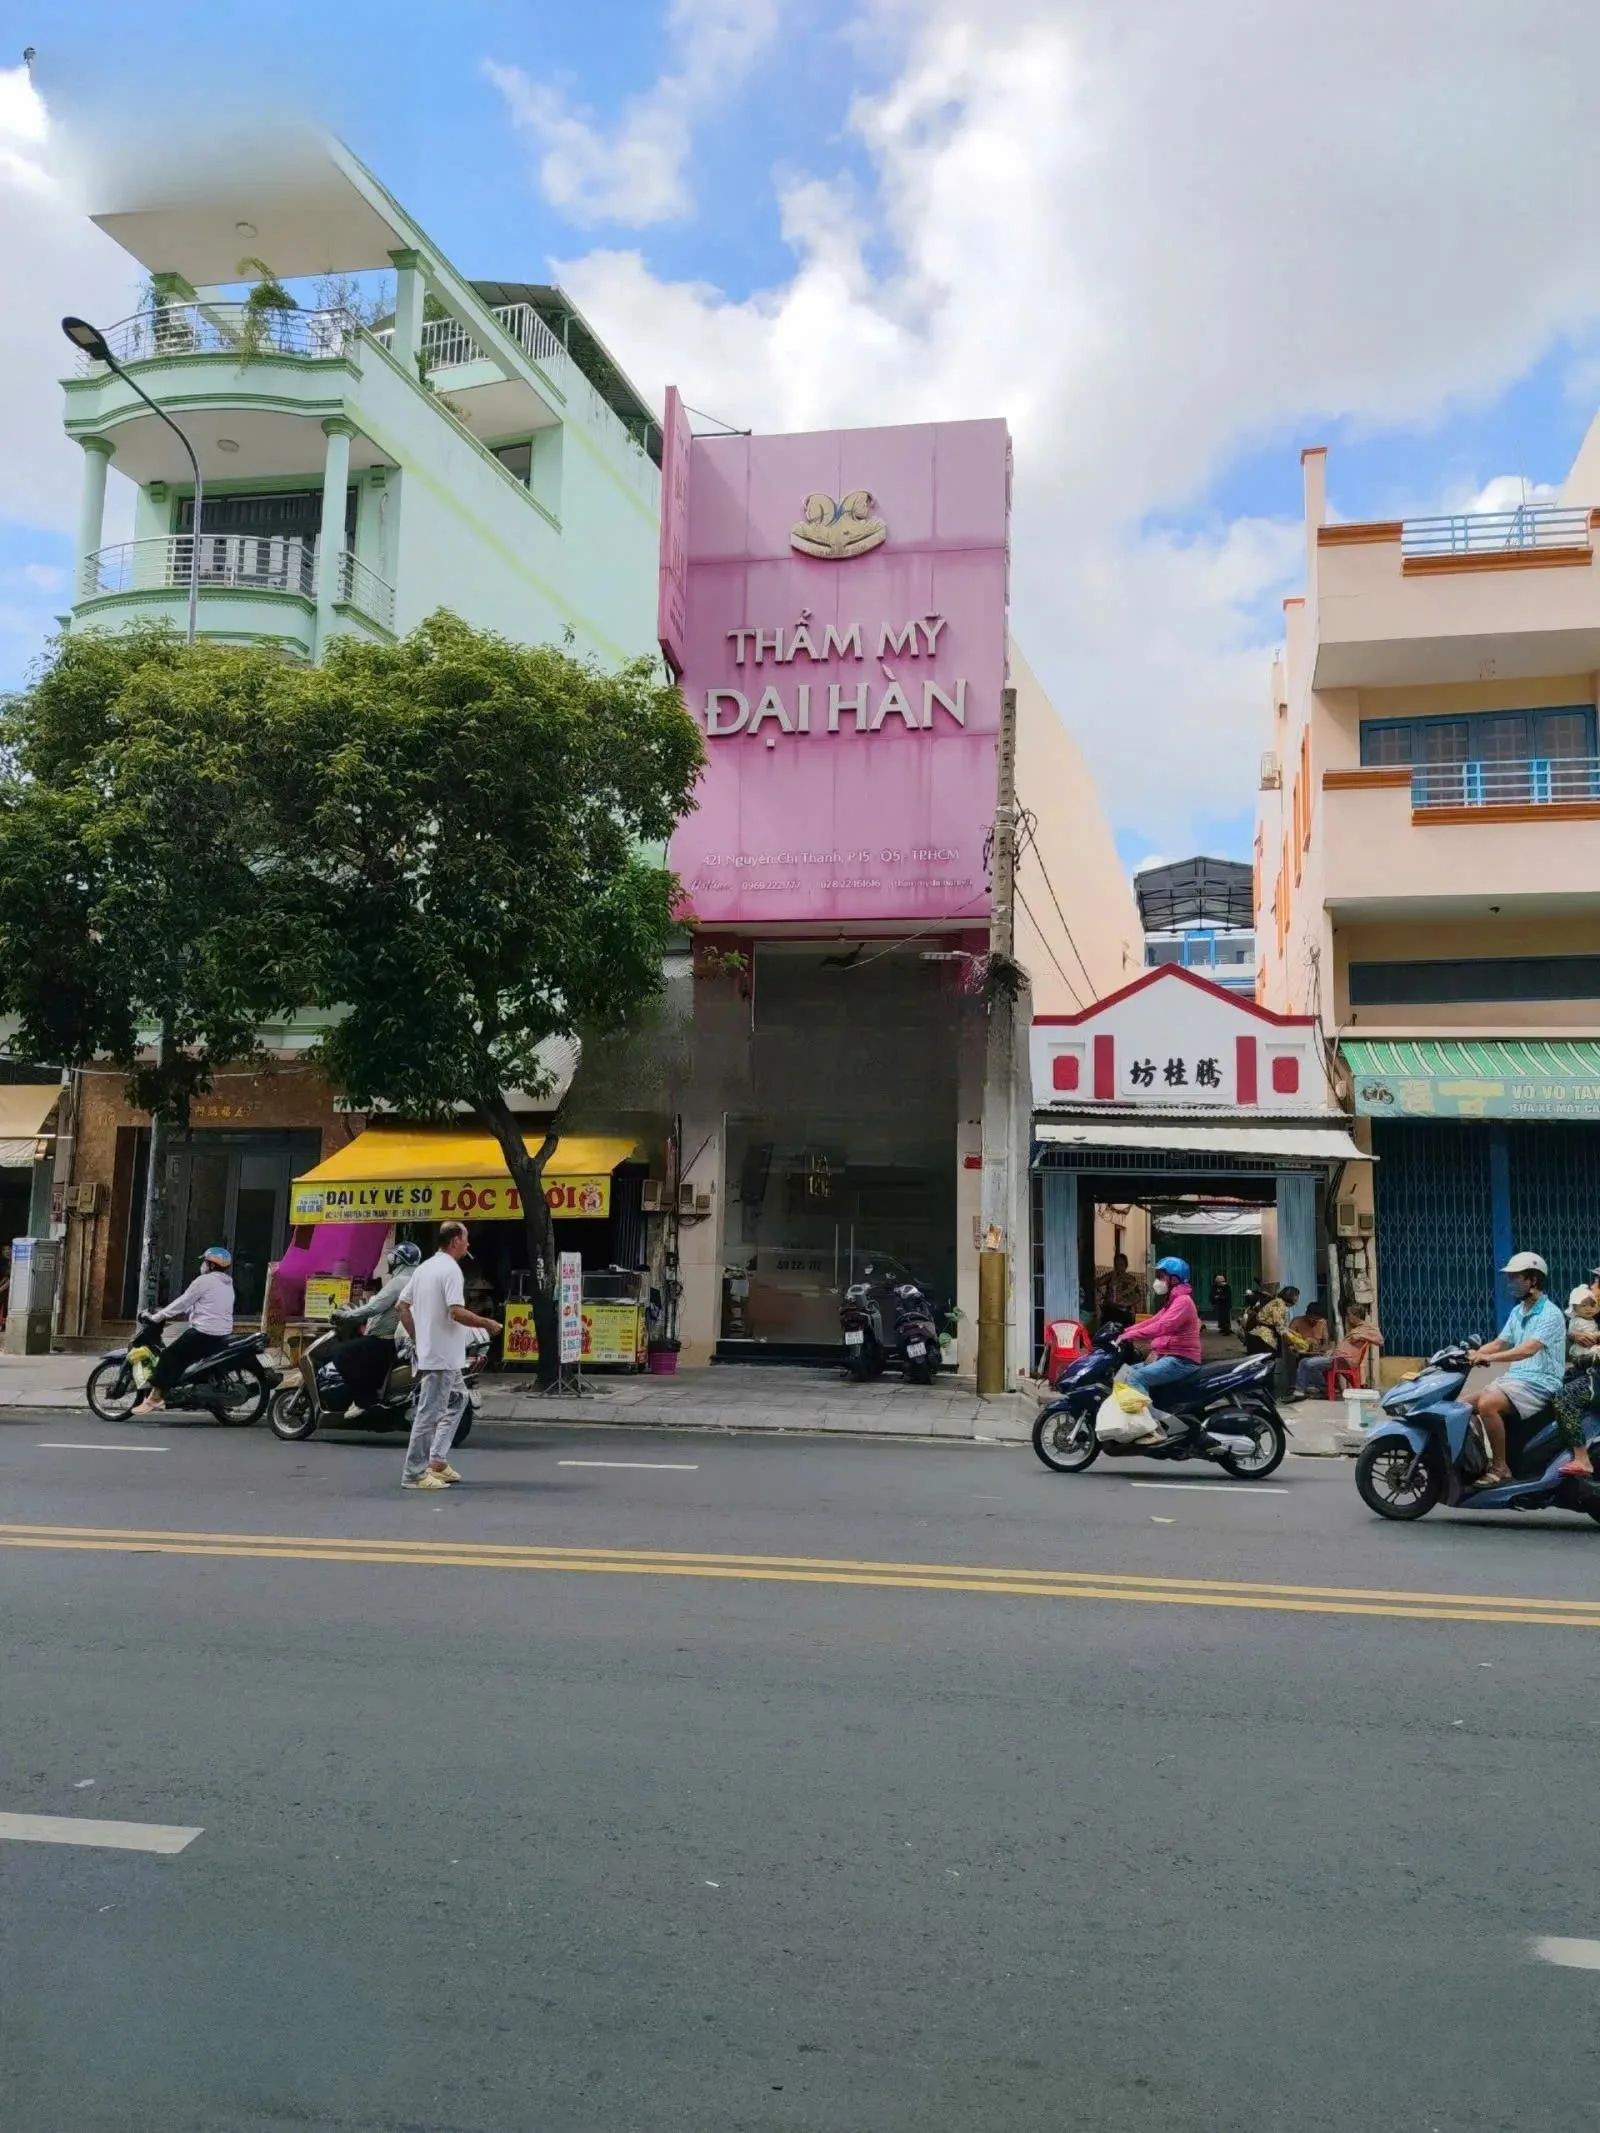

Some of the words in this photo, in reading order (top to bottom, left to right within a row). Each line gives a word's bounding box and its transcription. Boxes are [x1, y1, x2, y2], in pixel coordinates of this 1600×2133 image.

[727, 607, 864, 665] THẨM
[876, 611, 948, 658] MỸ
[704, 684, 811, 749] ĐẠI
[827, 664, 968, 733] HÀN
[326, 1189, 354, 1209] ĐẠI
[360, 1186, 379, 1205] LÝ
[384, 1185, 404, 1204] VÉ
[410, 1183, 433, 1204] SỐ
[440, 1182, 496, 1217] LỘC
[505, 1180, 577, 1210] TỜI
